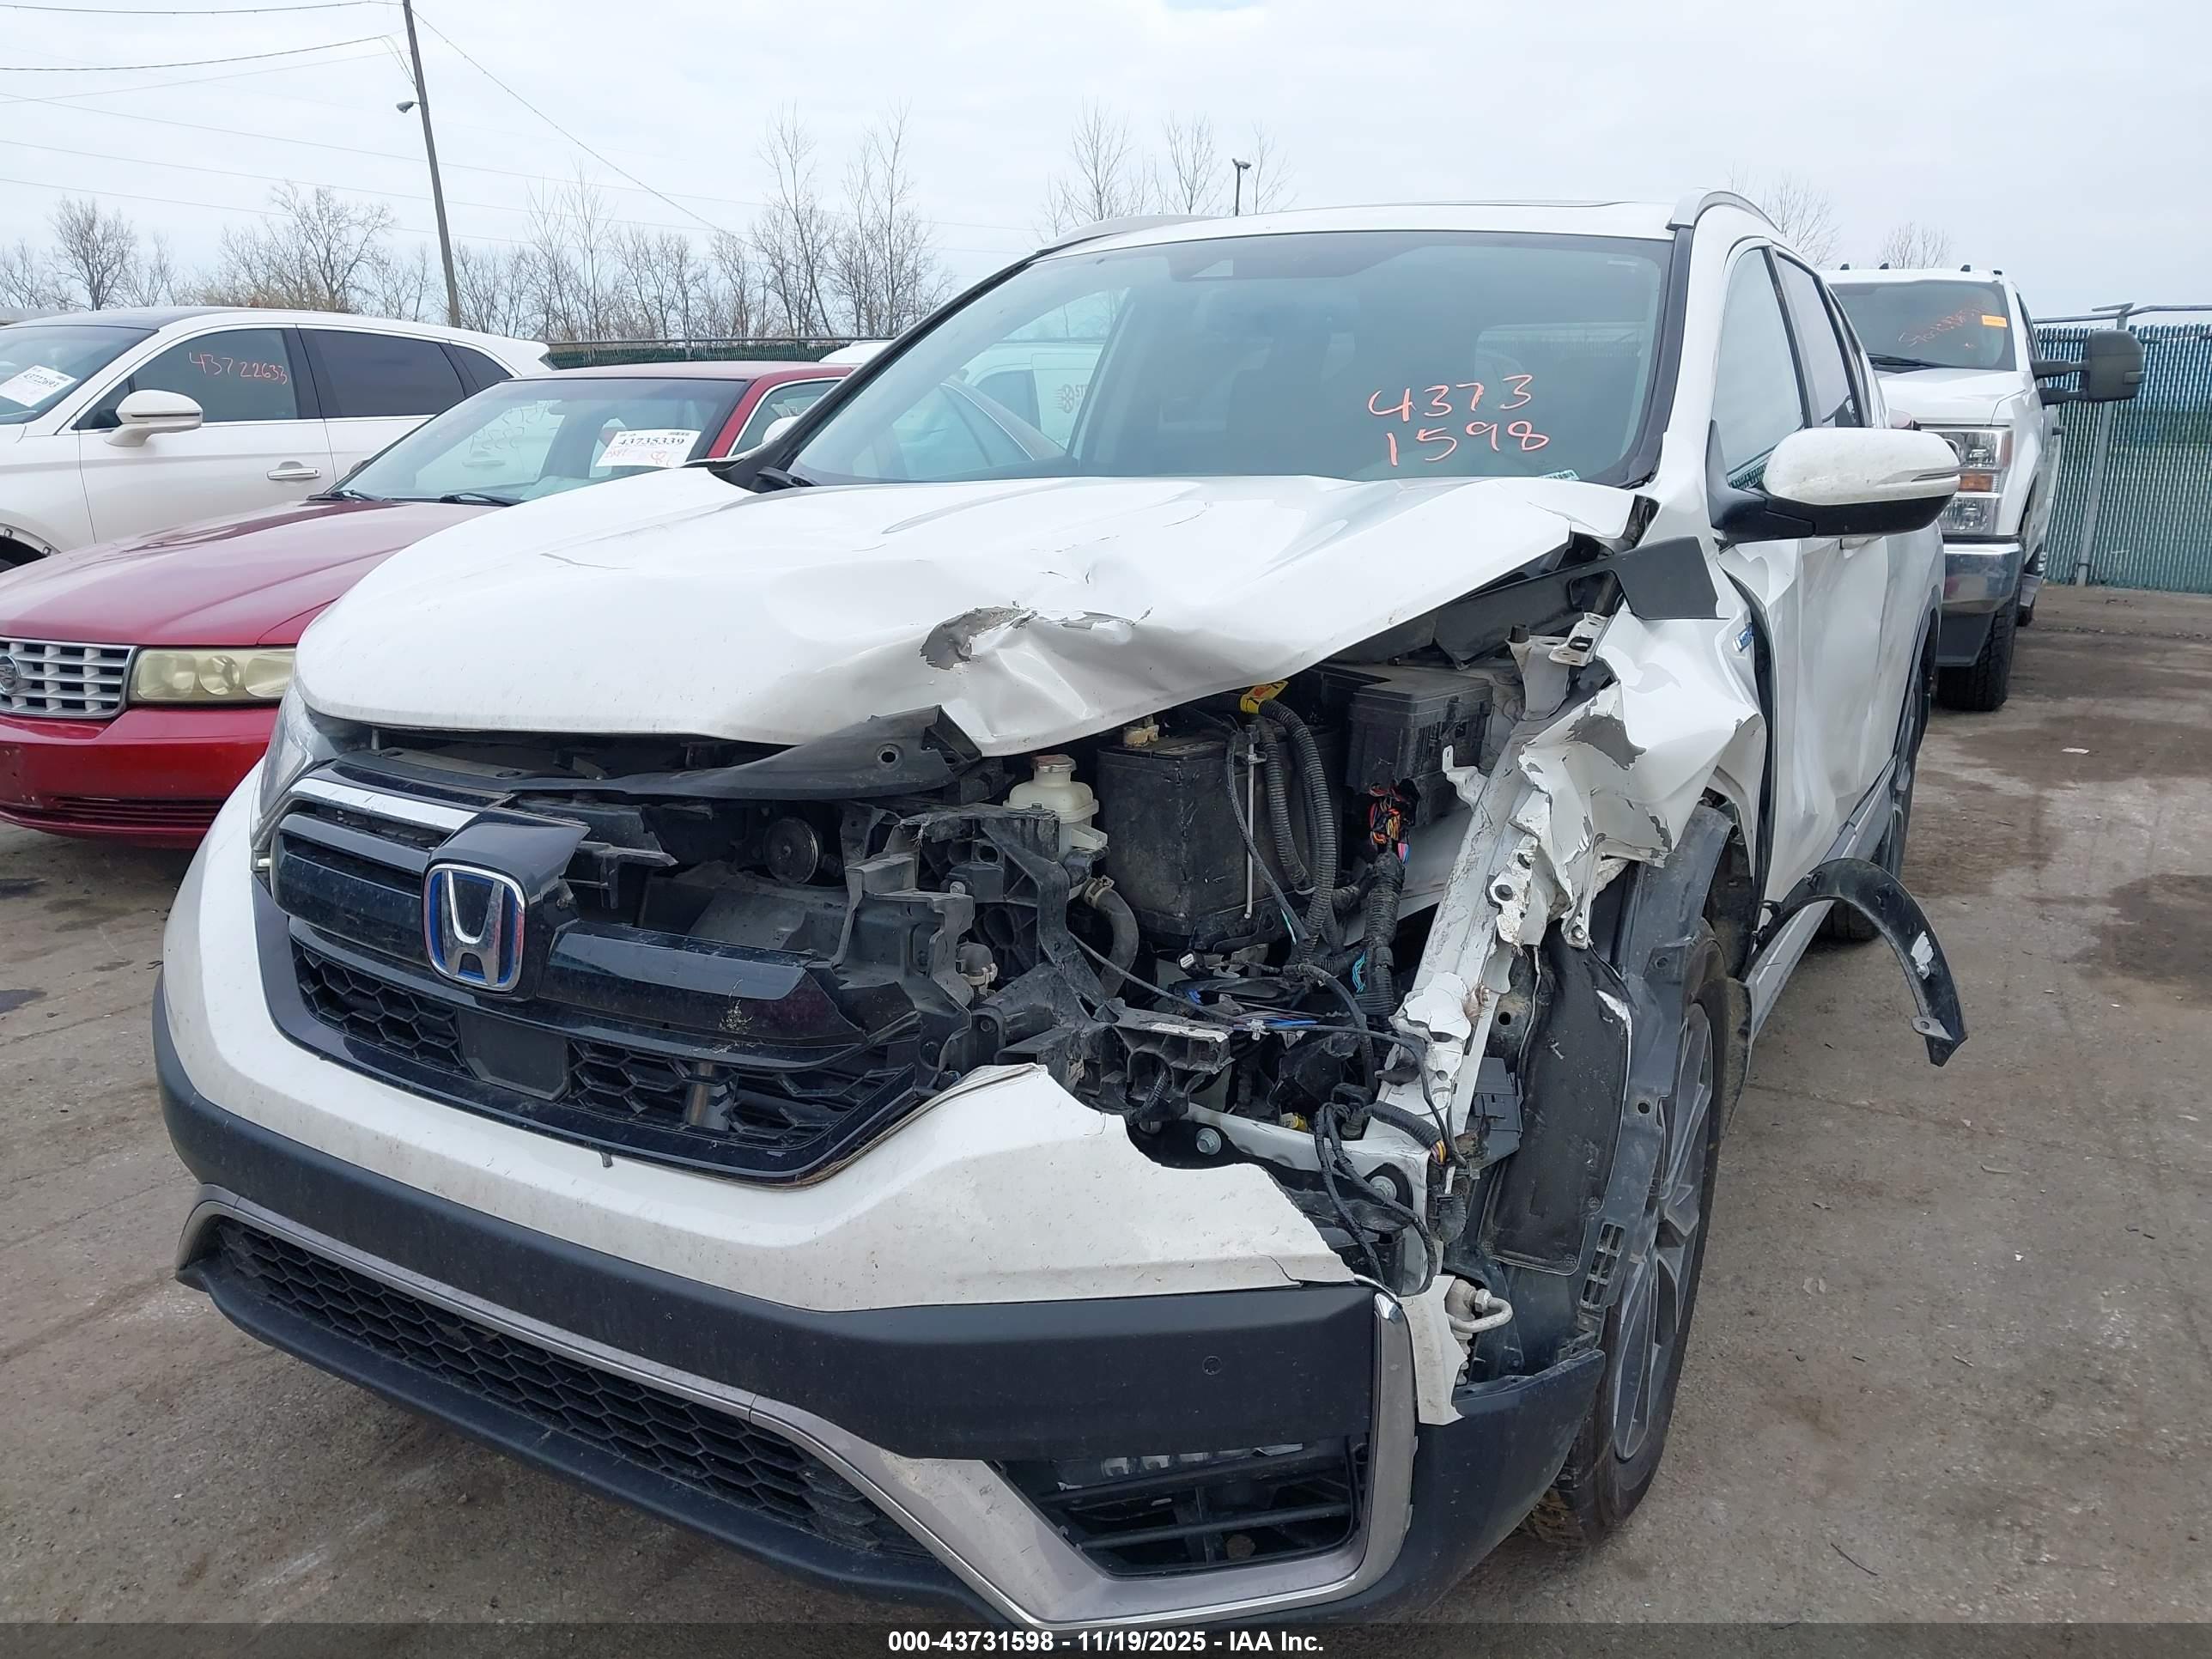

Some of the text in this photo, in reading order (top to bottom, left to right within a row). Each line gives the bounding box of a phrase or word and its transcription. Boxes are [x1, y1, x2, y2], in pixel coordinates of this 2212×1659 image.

[188, 351, 288, 386] 43722633
[1367, 373, 1534, 422] 4373
[617, 436, 685, 447] 43735339
[1385, 419, 1551, 467] 1598
